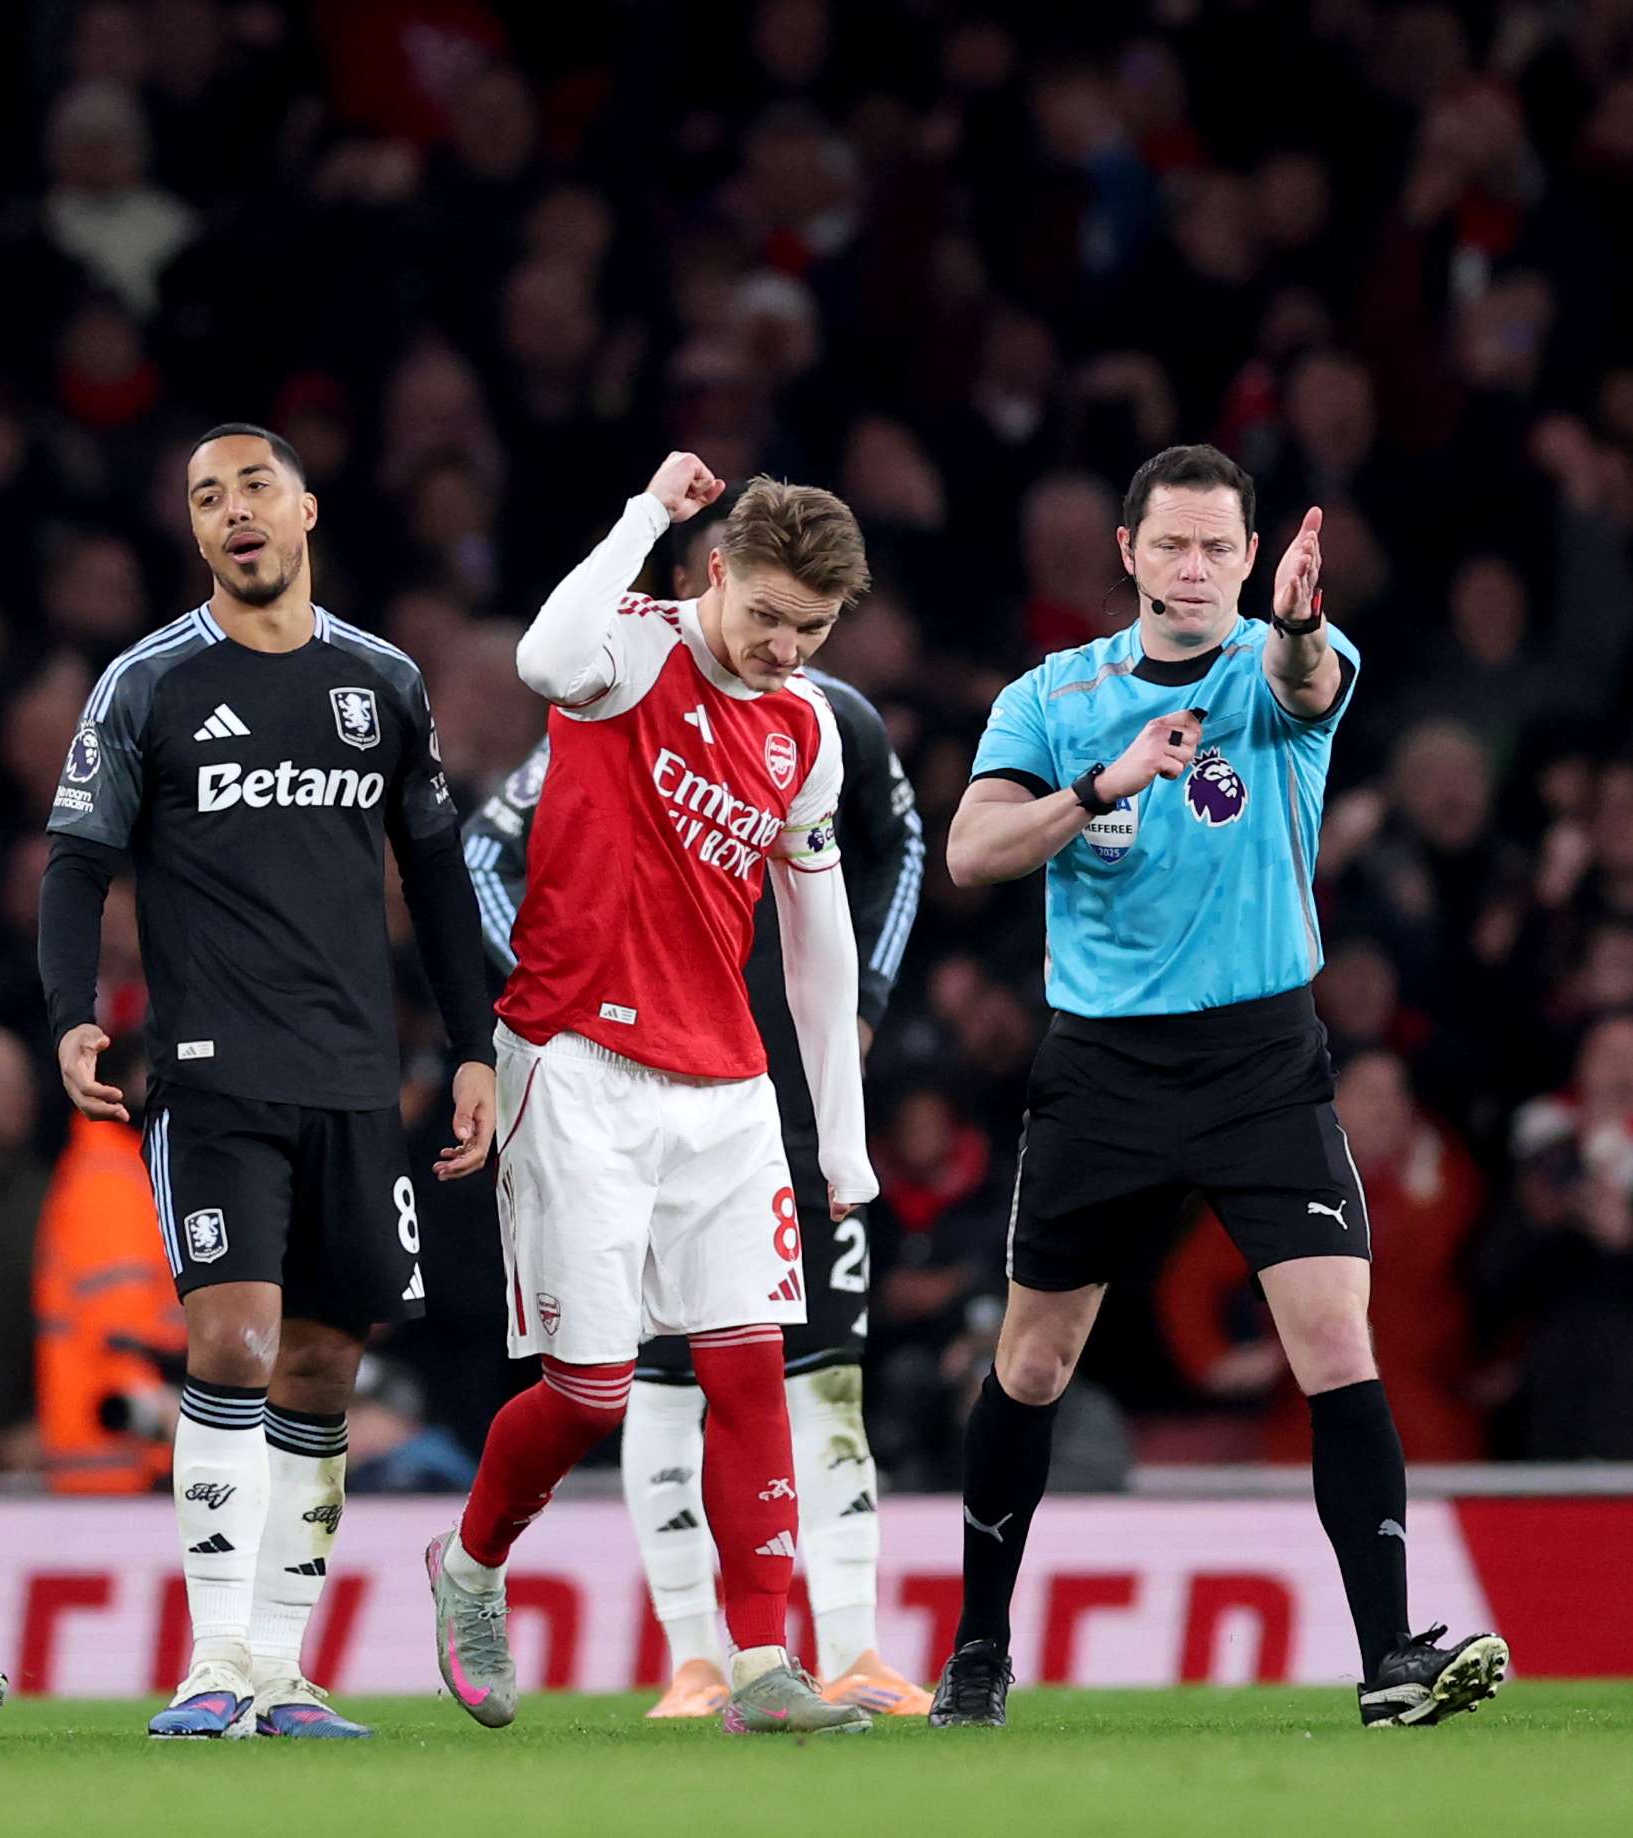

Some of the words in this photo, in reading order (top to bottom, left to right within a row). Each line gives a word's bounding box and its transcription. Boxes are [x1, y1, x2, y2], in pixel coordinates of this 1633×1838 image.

[198, 760, 384, 812] Betano
[1098, 848, 1120, 857] 2025
[393, 1175, 420, 1254] 8
[772, 1186, 800, 1262] 8
[829, 1218, 870, 1293] 2
